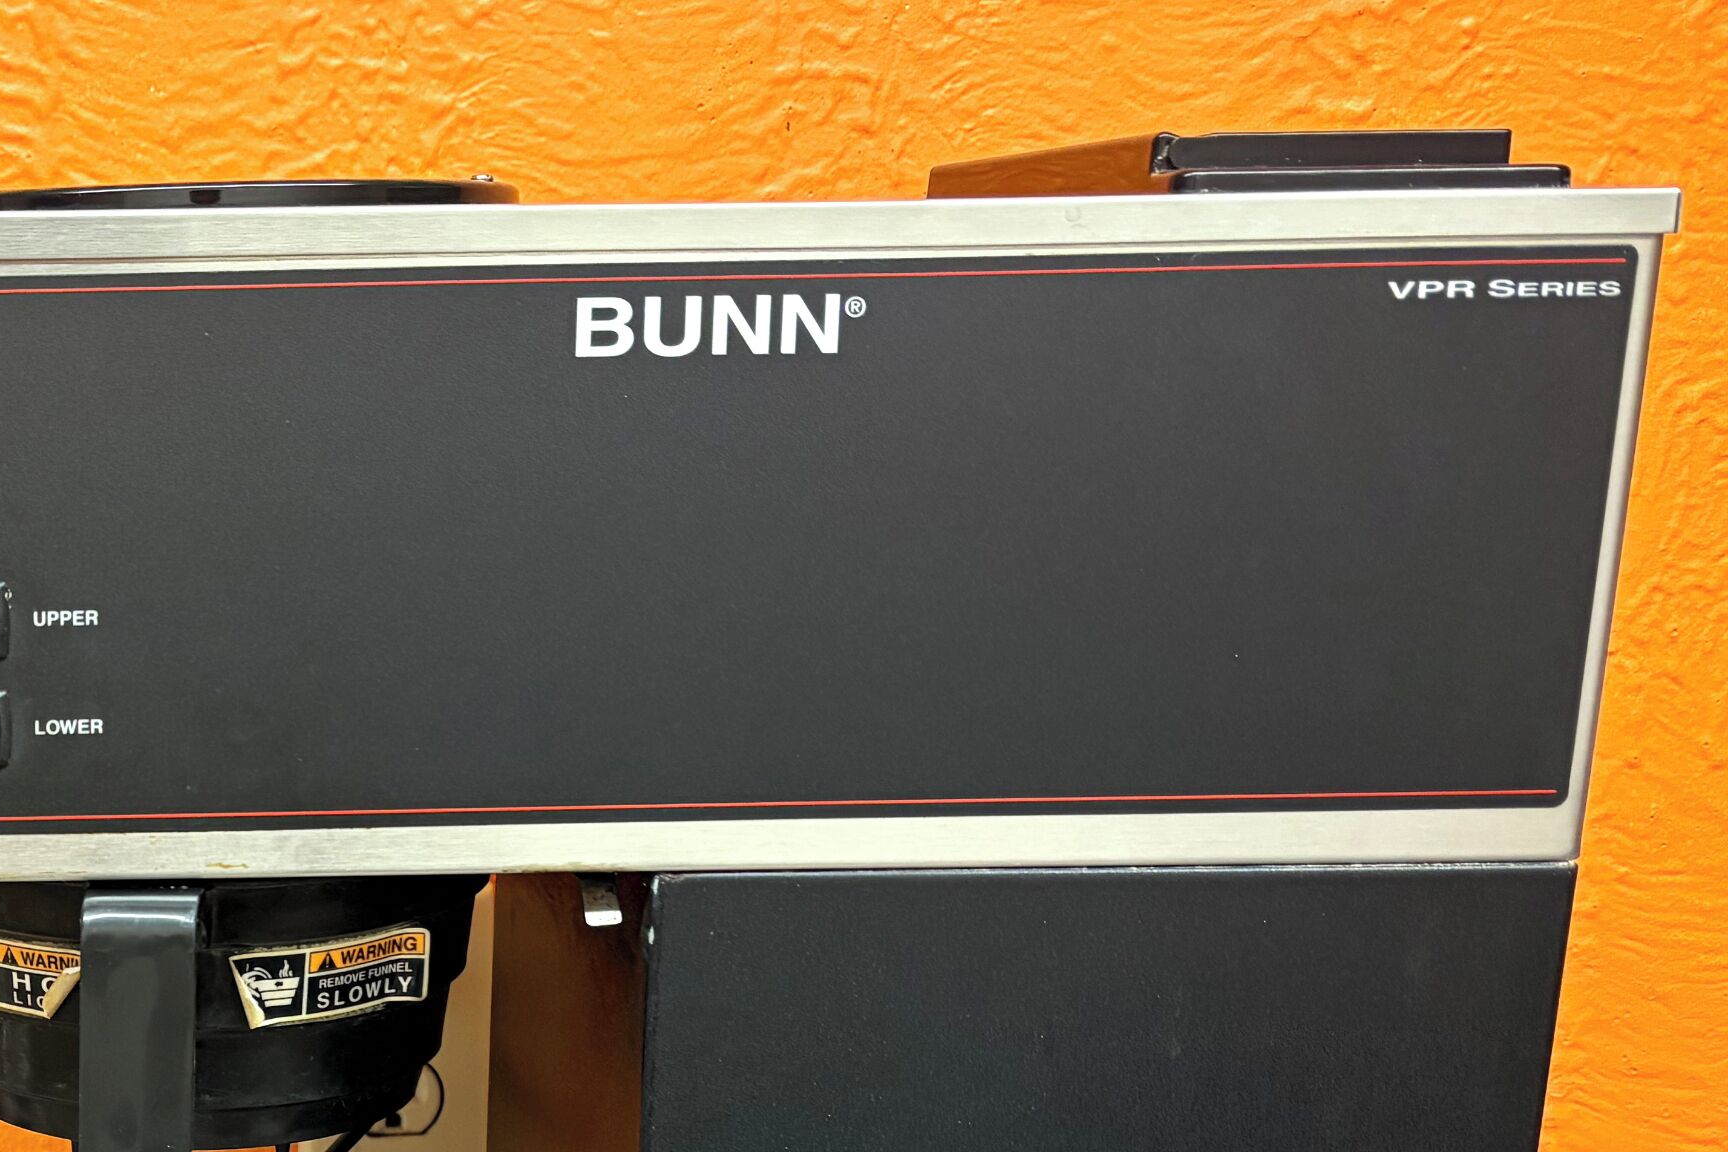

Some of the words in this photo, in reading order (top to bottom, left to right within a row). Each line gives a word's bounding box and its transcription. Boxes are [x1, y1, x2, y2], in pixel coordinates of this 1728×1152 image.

[1388, 280, 1476, 299] VPR
[33, 610, 98, 627] UPPER
[34, 718, 104, 735] LOWER
[340, 936, 418, 964] WARNING
[318, 970, 366, 988] REMOVE
[368, 962, 412, 978] FUNNEL
[316, 976, 412, 1008] SLOWLY
